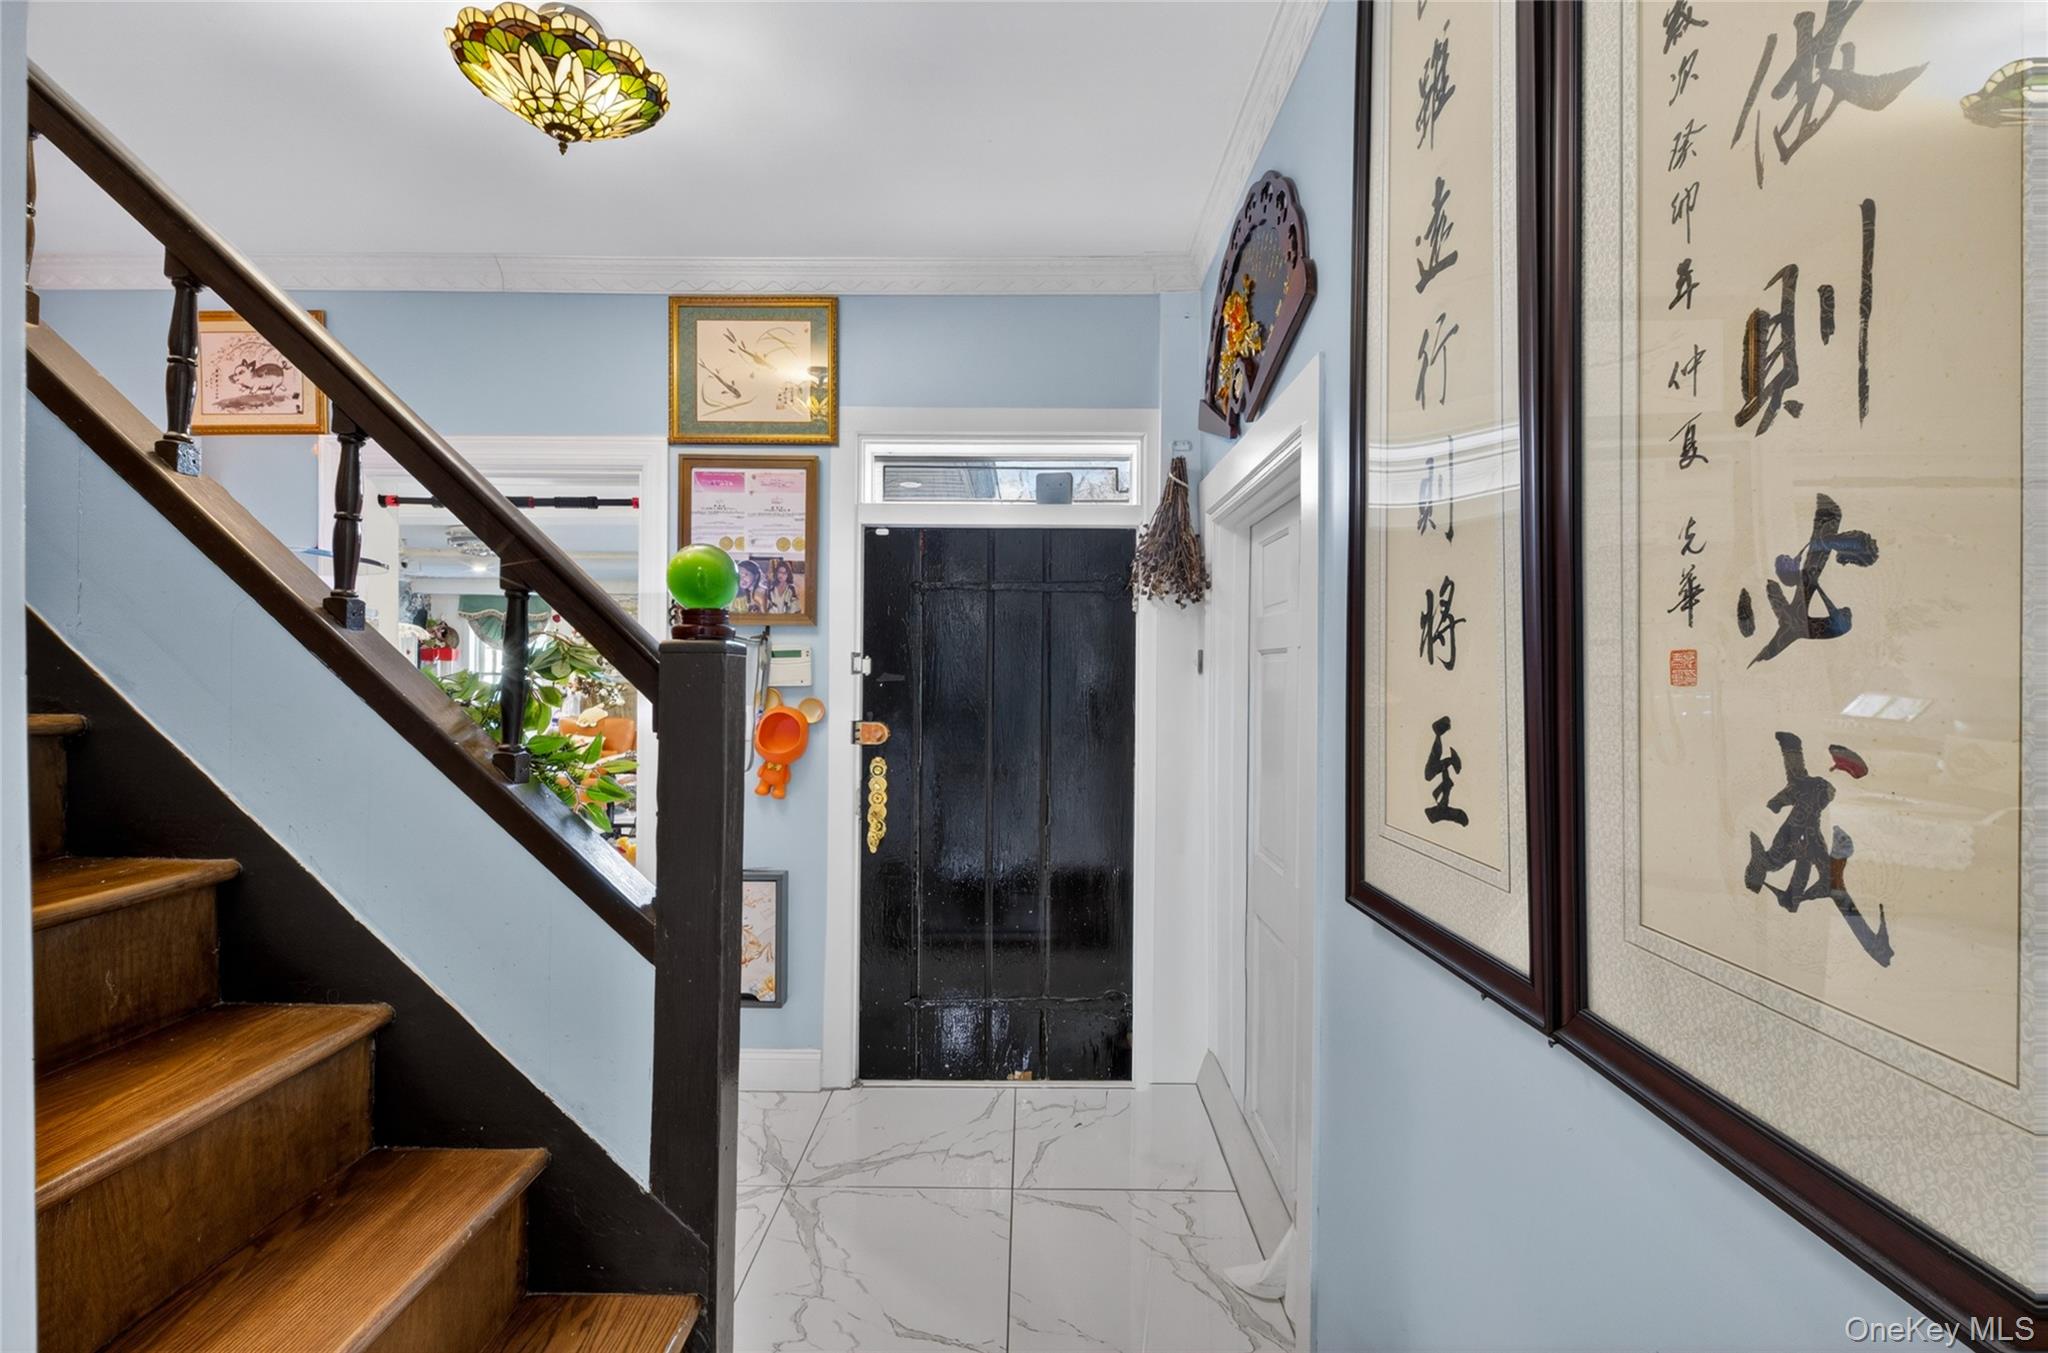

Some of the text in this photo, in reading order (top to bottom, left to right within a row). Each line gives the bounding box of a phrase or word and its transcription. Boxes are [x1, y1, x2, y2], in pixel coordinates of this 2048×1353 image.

[1416, 0, 1469, 827] 雖遠行則將至
